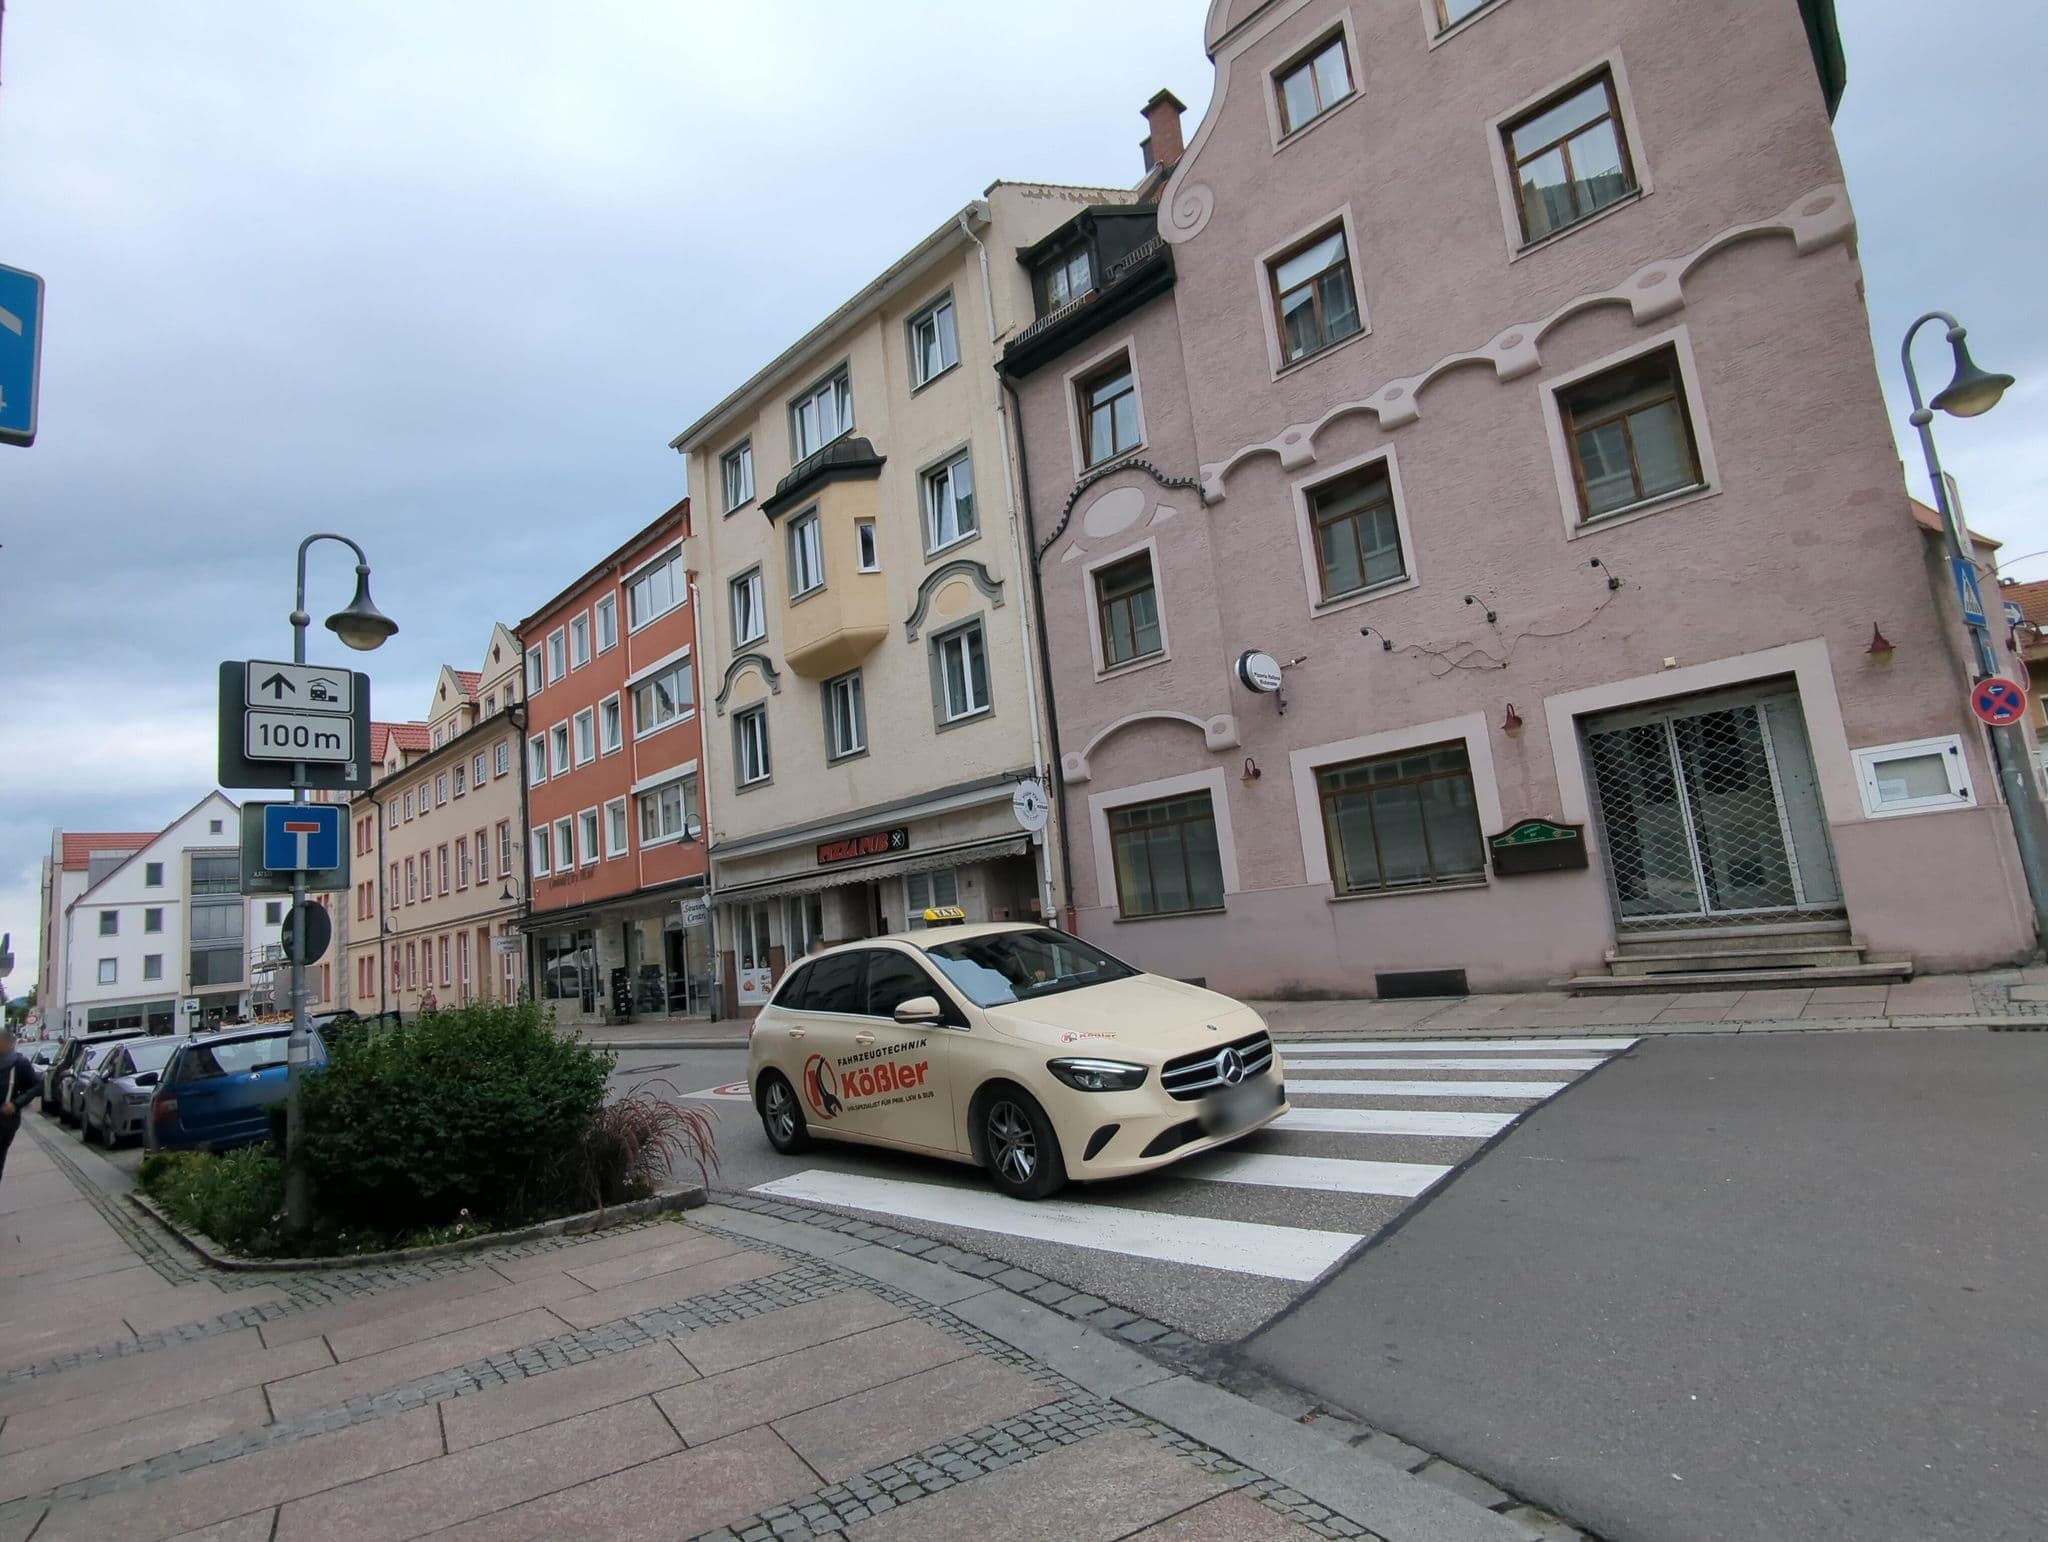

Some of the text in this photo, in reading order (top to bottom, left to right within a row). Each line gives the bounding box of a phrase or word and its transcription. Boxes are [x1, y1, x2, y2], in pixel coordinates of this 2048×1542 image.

[819, 831, 889, 864] PIZZA PUB
[683, 903, 706, 913] Souven
[687, 913, 706, 922] Centr
[930, 907, 962, 918] TAXI
[837, 1038, 928, 1067] FAHRZEUGTECHNIK
[841, 1060, 929, 1099] Kößler
